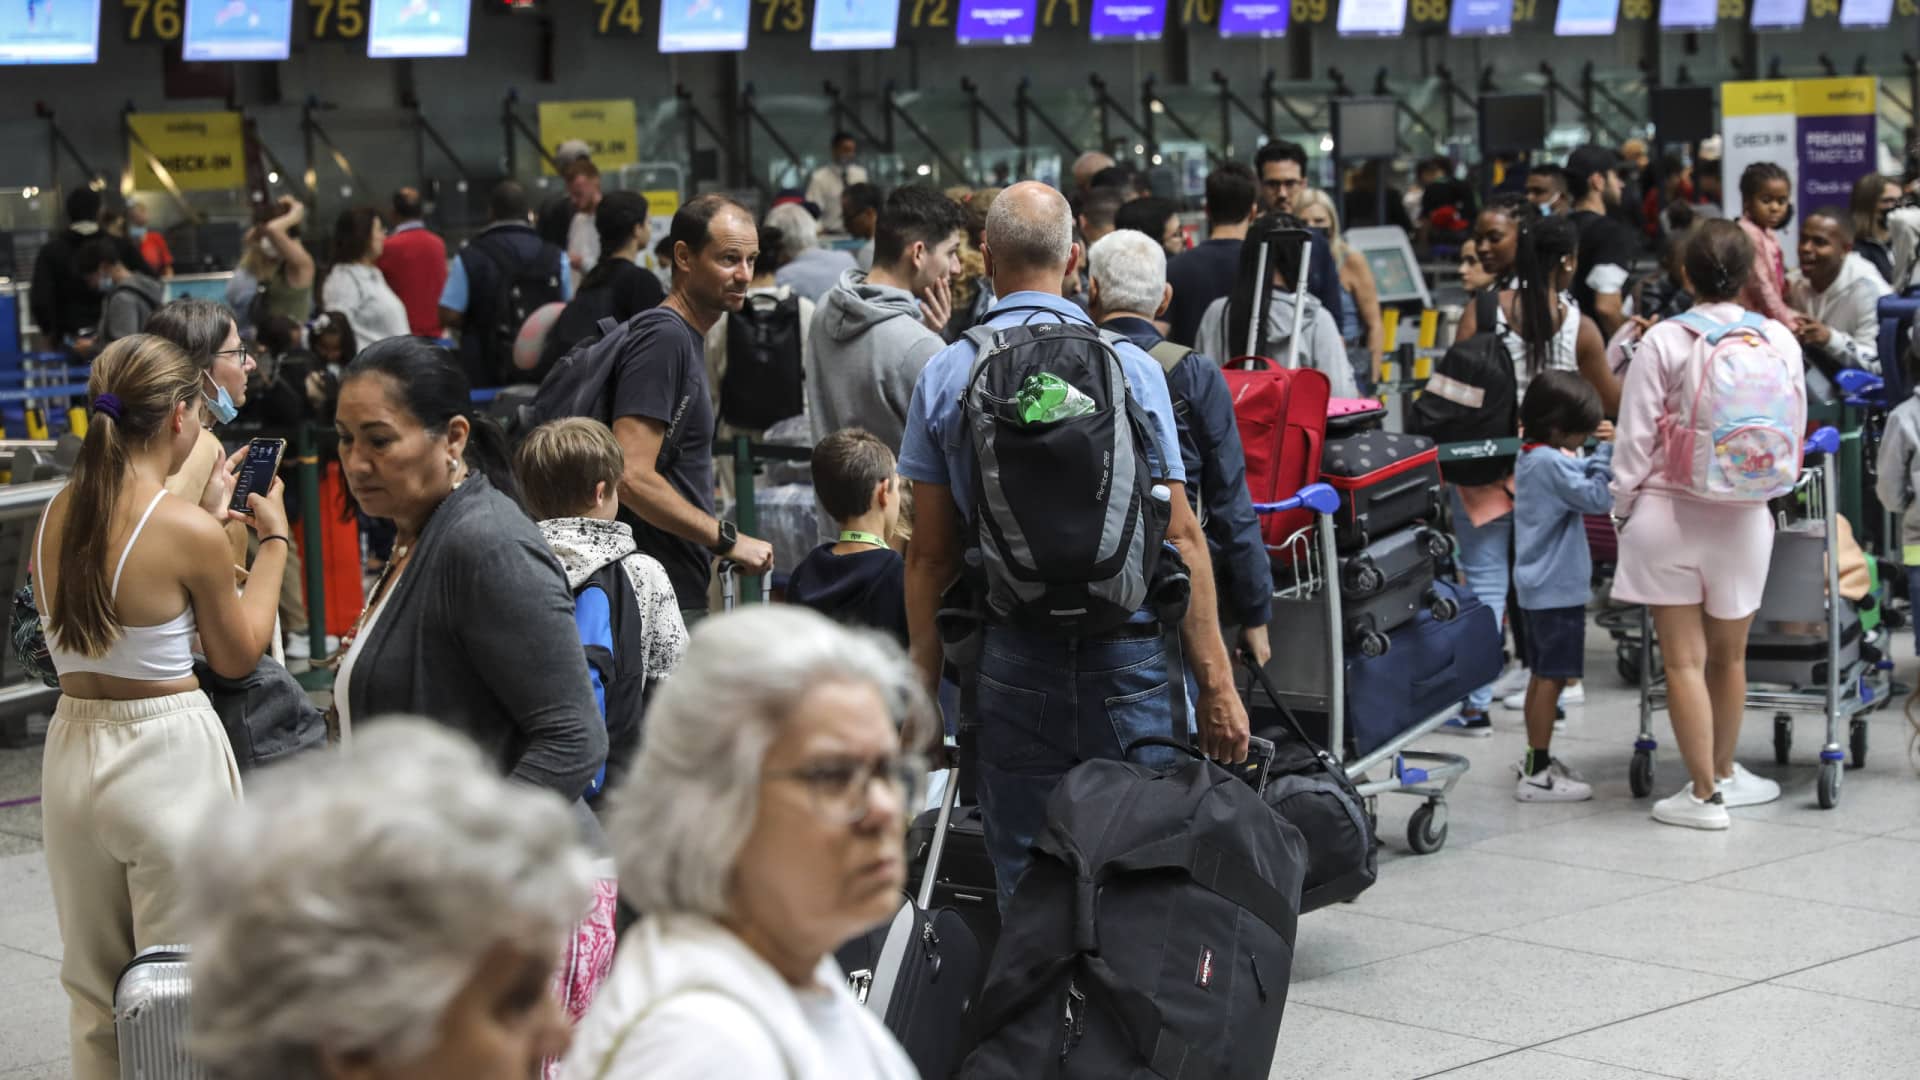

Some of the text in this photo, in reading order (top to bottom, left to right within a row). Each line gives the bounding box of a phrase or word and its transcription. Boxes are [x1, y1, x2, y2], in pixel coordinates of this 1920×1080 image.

[122, 0, 181, 40] 76
[308, 0, 364, 38] 75
[594, 0, 643, 34] 74
[757, 0, 805, 32] 73
[1806, 130, 1866, 147] PREMIUM
